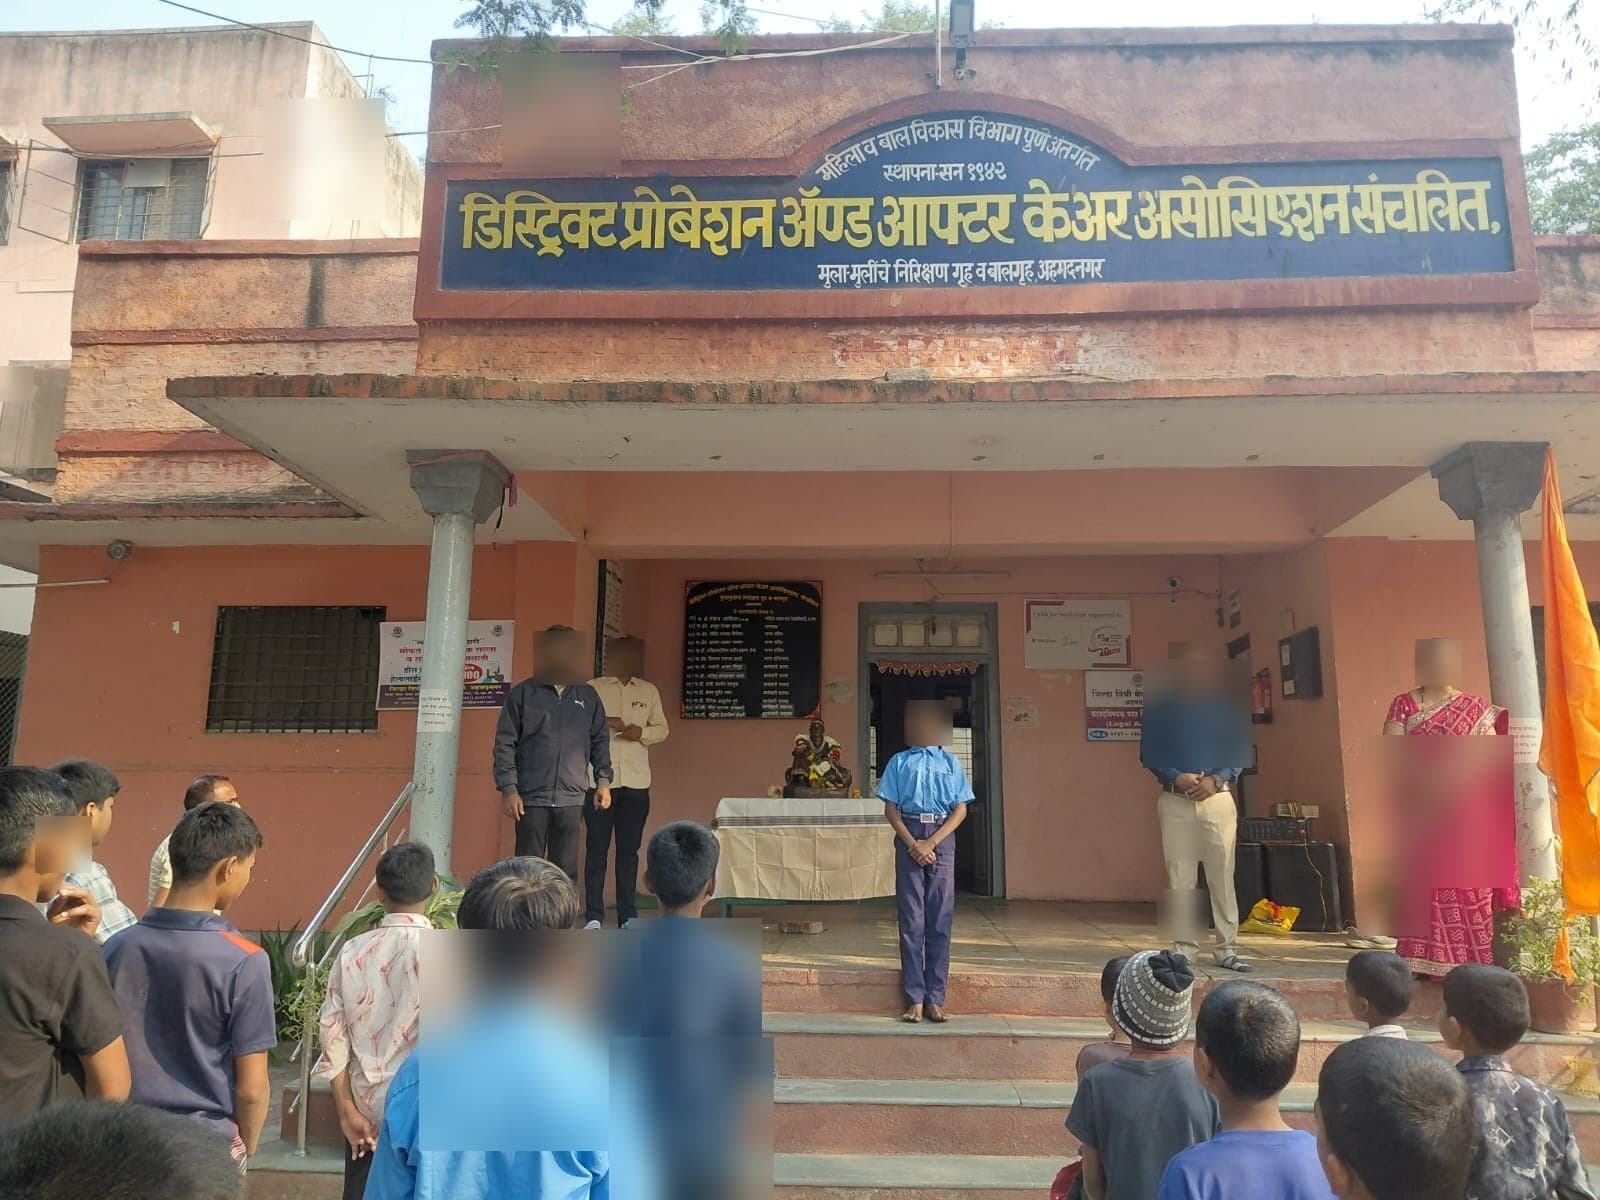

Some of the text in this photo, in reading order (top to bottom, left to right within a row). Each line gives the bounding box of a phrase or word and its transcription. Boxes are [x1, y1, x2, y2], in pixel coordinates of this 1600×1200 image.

[815, 116, 1100, 180] महिला व बाल विकास विभाग पुणे अंतर्गत
[967, 161, 1007, 181] १९४२
[459, 190, 618, 258] डिस्ट्रिक्ट
[619, 185, 776, 256] प्रोबेशन
[1022, 178, 1132, 243] केअर
[1134, 174, 1350, 242] असोसिएशन
[1352, 169, 1500, 234] संचलित,
[893, 259, 949, 284] निरिक्षण
[952, 261, 974, 288] गृह
[976, 261, 986, 283] व
[1038, 258, 1105, 283] अहमदनगर
